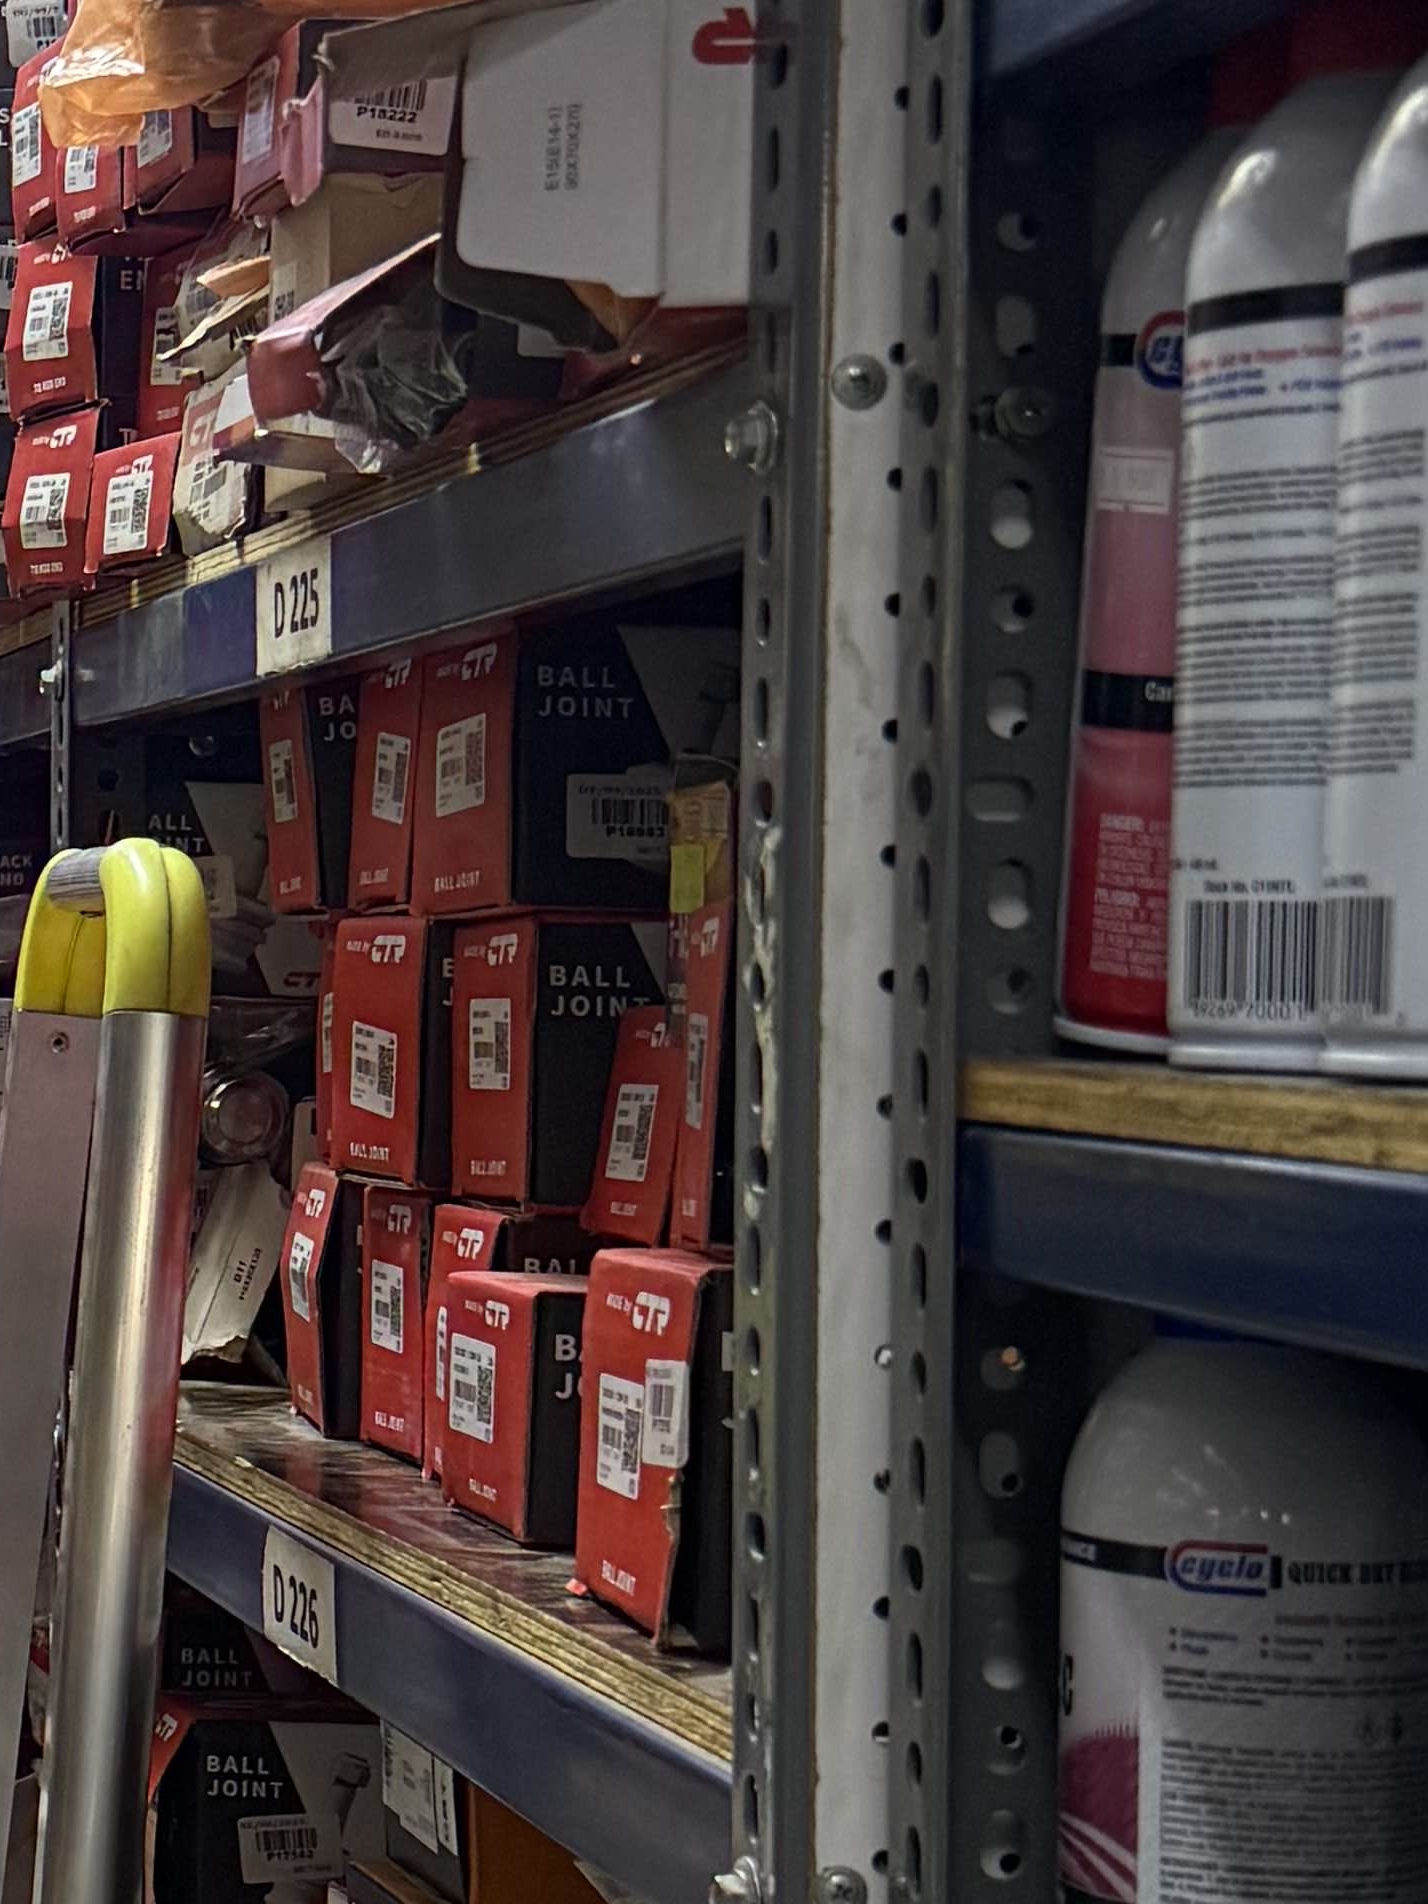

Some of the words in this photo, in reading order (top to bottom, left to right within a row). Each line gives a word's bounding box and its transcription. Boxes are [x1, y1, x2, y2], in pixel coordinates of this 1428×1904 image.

[273, 587, 285, 638] D
[288, 567, 320, 633] 225
[537, 666, 615, 688] BALL
[537, 696, 634, 718] JOINT
[371, 935, 406, 964] CTR
[549, 966, 631, 987] BALL
[631, 1291, 670, 1336] CTR
[1181, 1556, 1263, 1581] cyclo
[272, 1577, 286, 1622] D
[288, 1575, 320, 1649] 226
[181, 1647, 239, 1665] BALL
[181, 1668, 253, 1686] JOINT
[207, 1755, 271, 1776] BALL
[207, 1778, 283, 1799] JOINT
